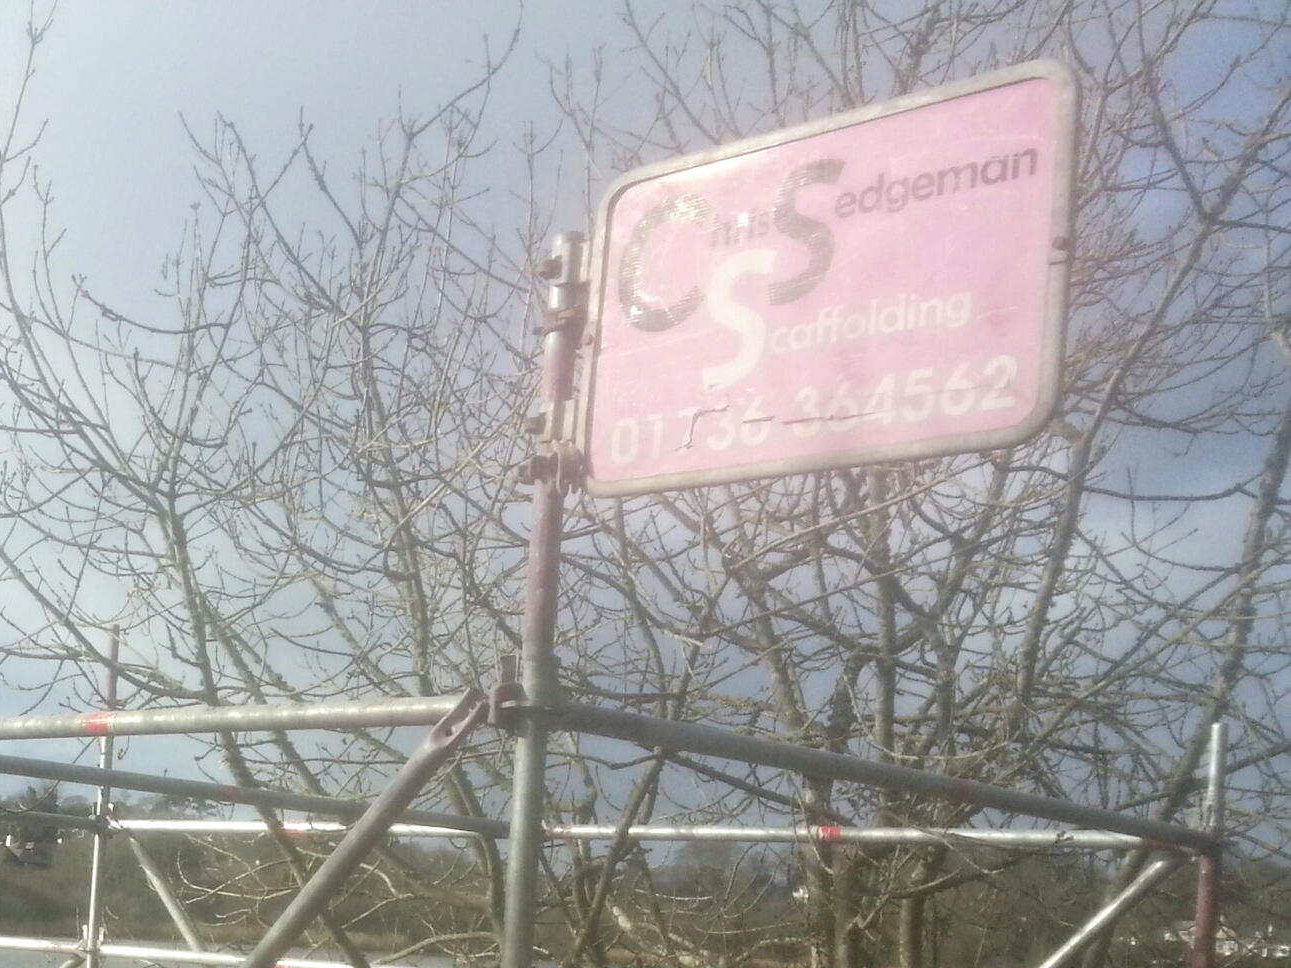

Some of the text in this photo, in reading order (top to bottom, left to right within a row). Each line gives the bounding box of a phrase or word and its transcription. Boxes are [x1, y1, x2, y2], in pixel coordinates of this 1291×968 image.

[769, 147, 1038, 306] Sedgeman
[703, 249, 972, 389] Scaffolding
[611, 355, 1018, 465] 01736 364562
